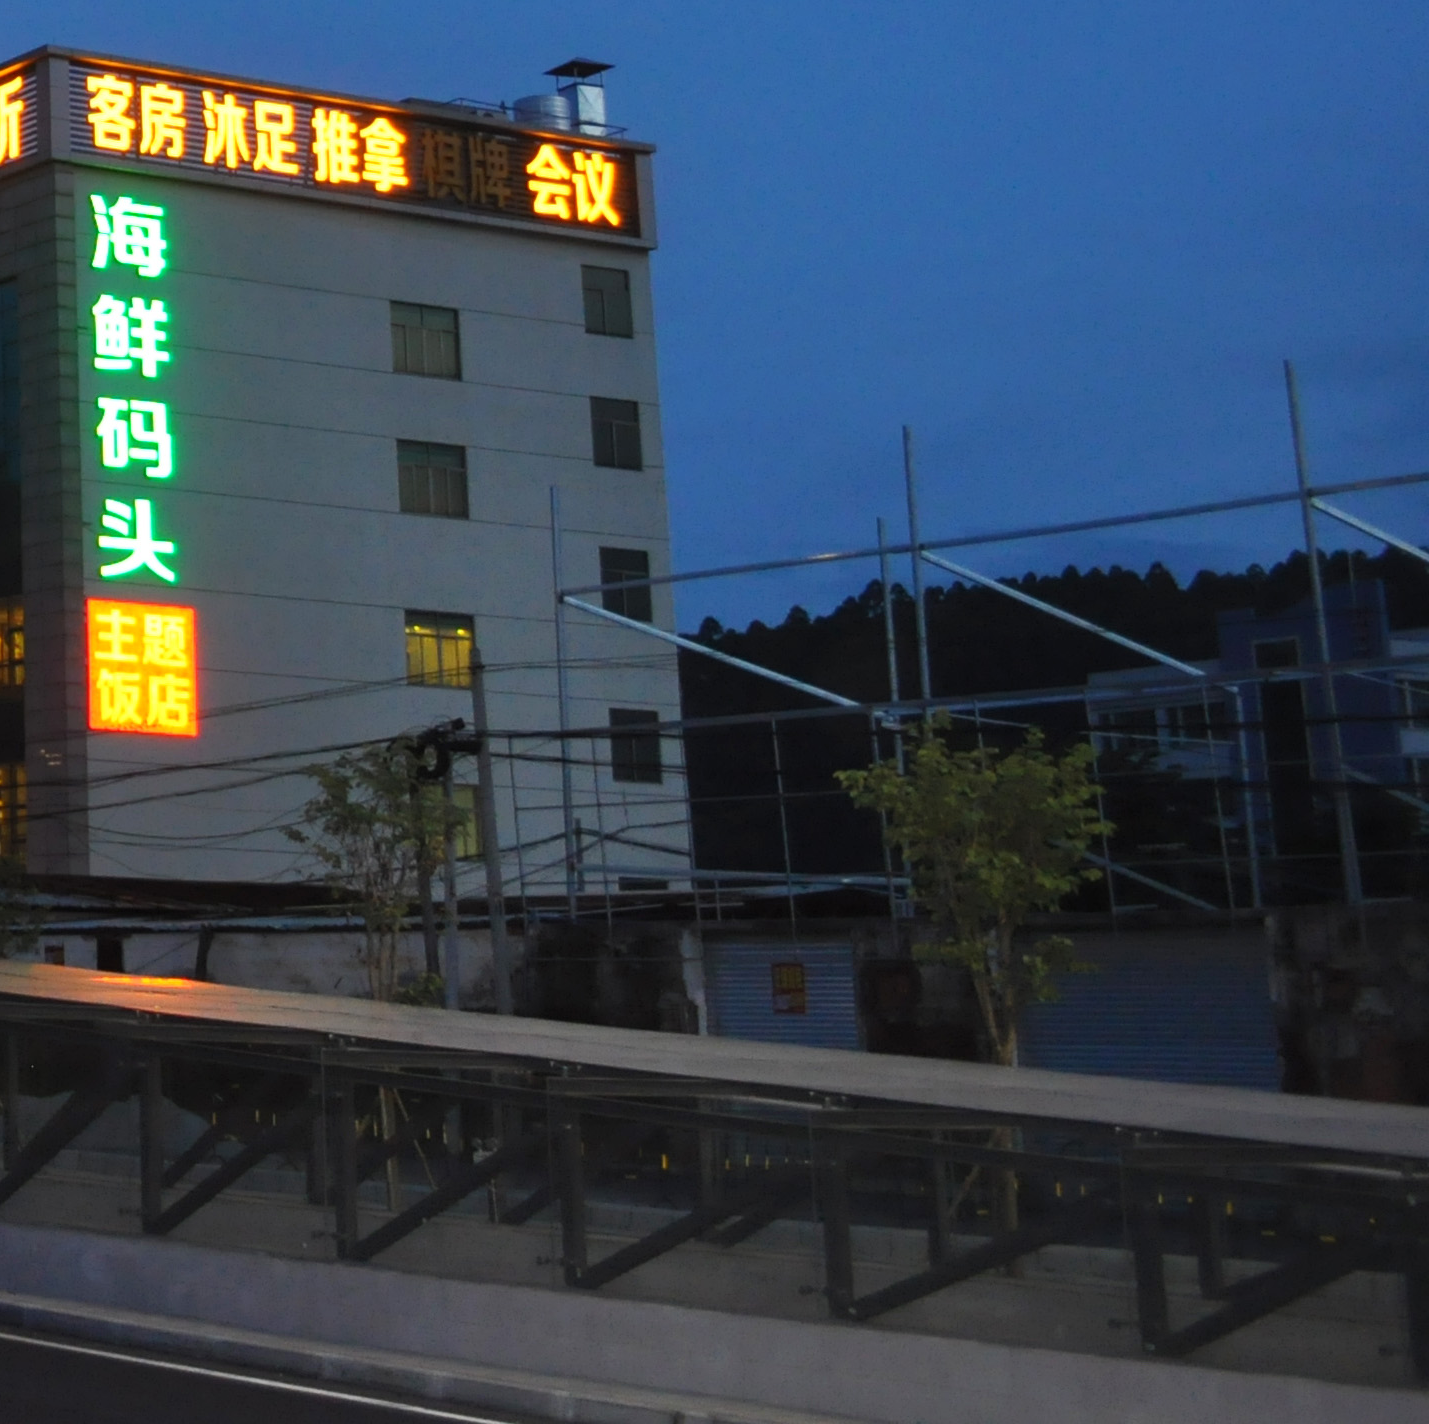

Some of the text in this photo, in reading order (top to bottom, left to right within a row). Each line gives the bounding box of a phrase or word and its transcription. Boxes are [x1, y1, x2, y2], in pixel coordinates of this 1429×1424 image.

[86, 74, 621, 227] 客房 沐足 推拿 棋牌 会议
[90, 193, 177, 583] 海鲜码头
[94, 609, 188, 668] 主题
[96, 667, 191, 728] 饭店
